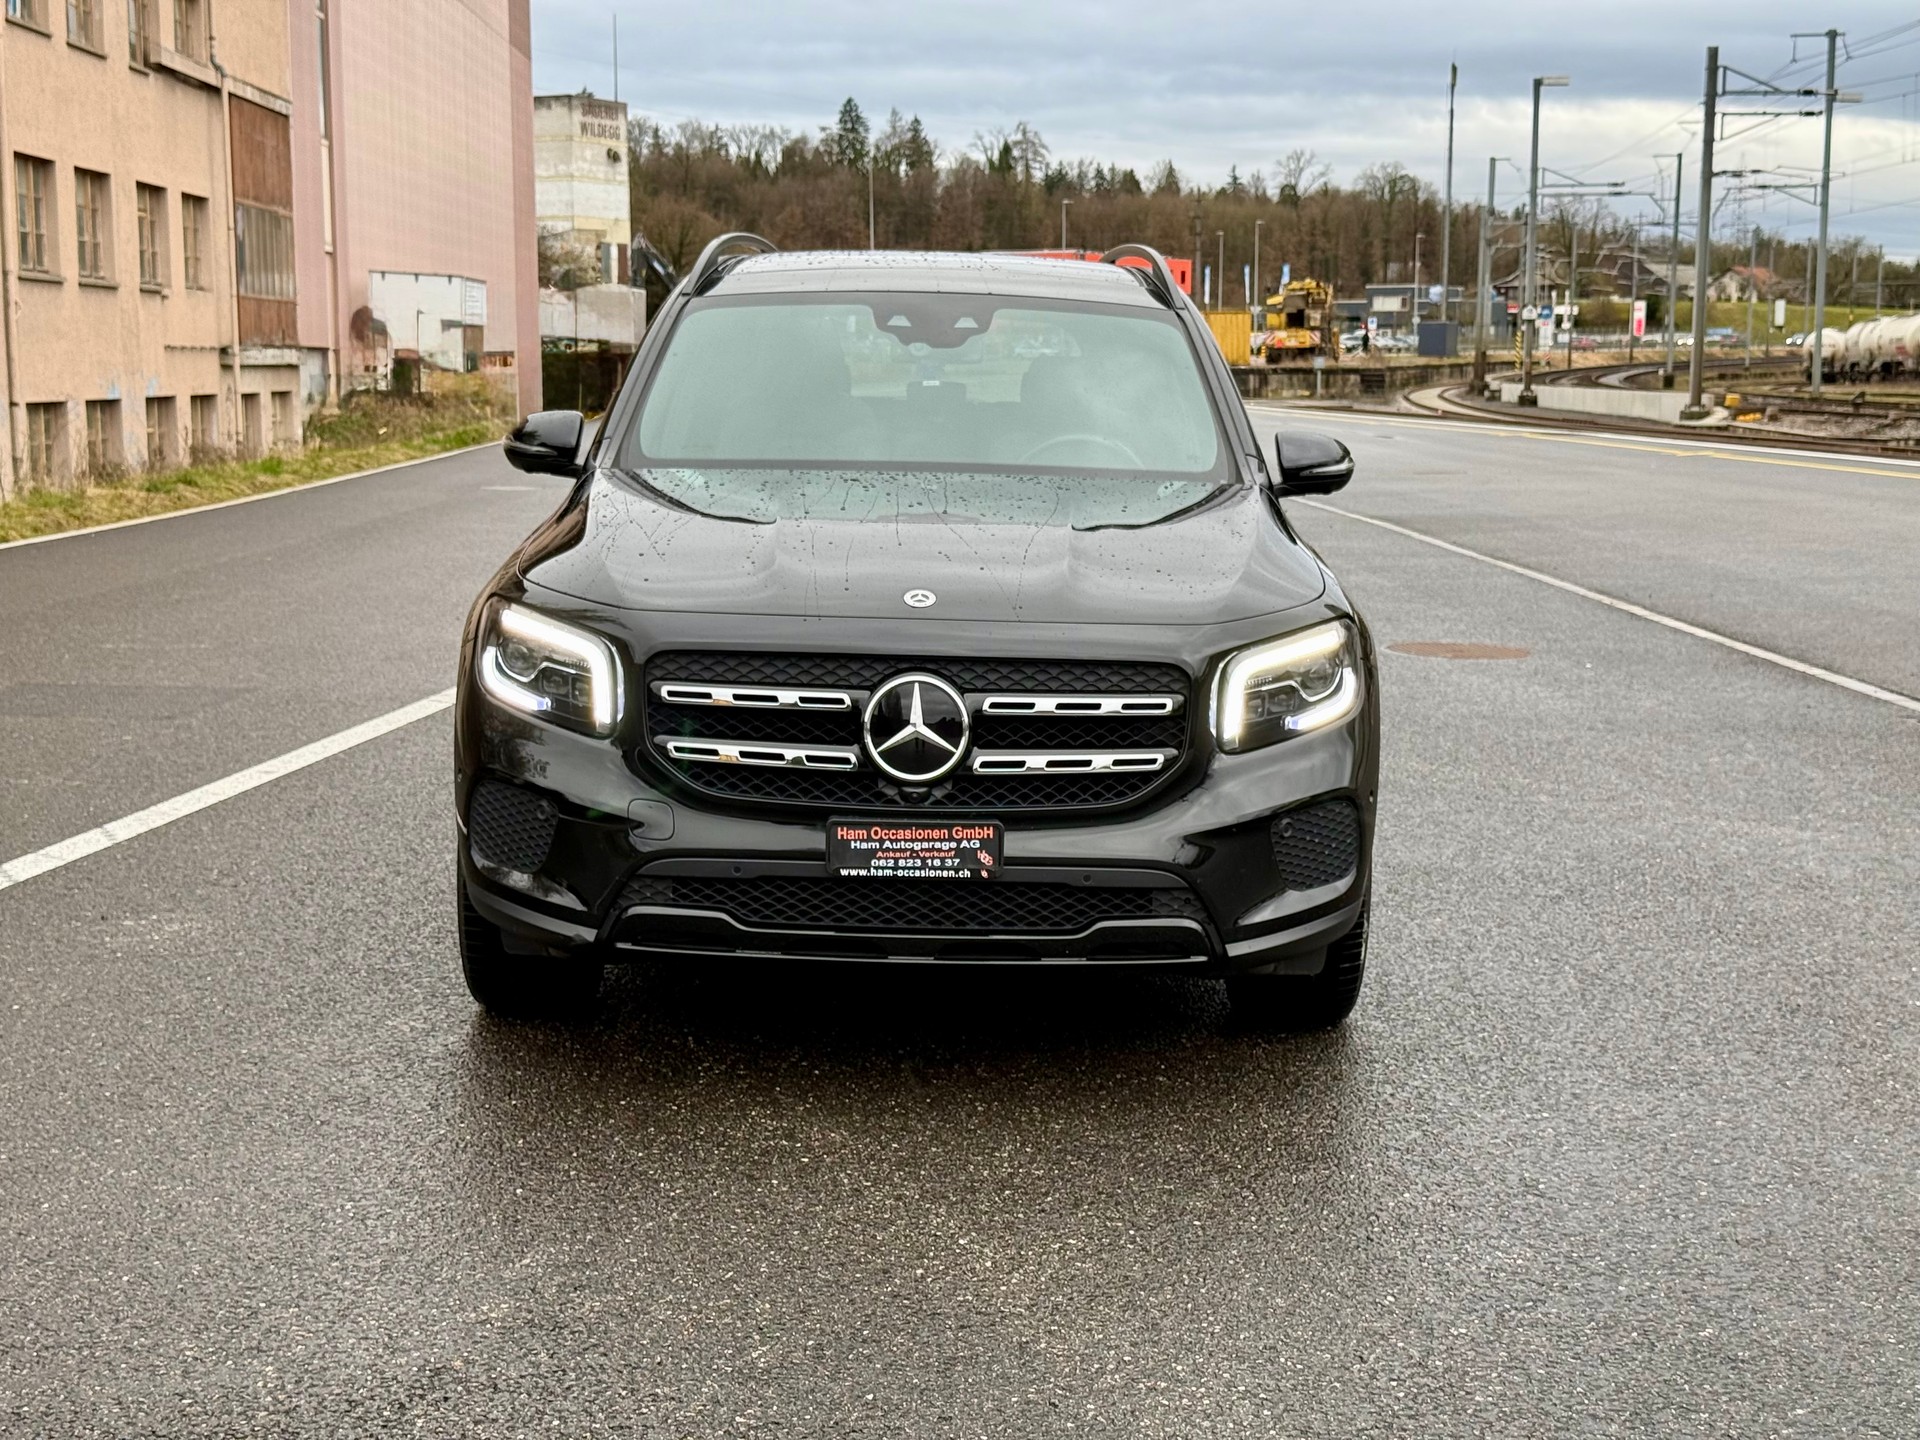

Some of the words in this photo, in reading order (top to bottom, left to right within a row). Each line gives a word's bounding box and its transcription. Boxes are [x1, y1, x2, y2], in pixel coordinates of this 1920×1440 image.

[579, 121, 621, 140] WILDEGG
[837, 826, 867, 840] Ham
[871, 826, 948, 840] Occasionen
[952, 826, 994, 839] GmbH
[850, 840, 880, 850] Ham
[882, 840, 957, 851] Autogarage
[959, 840, 981, 849] AG
[871, 858, 895, 867] 062
[898, 858, 922, 867] 823
[926, 858, 941, 867] 16
[945, 858, 961, 867] 37
[840, 867, 971, 878] www.ham-occasionen.ch
